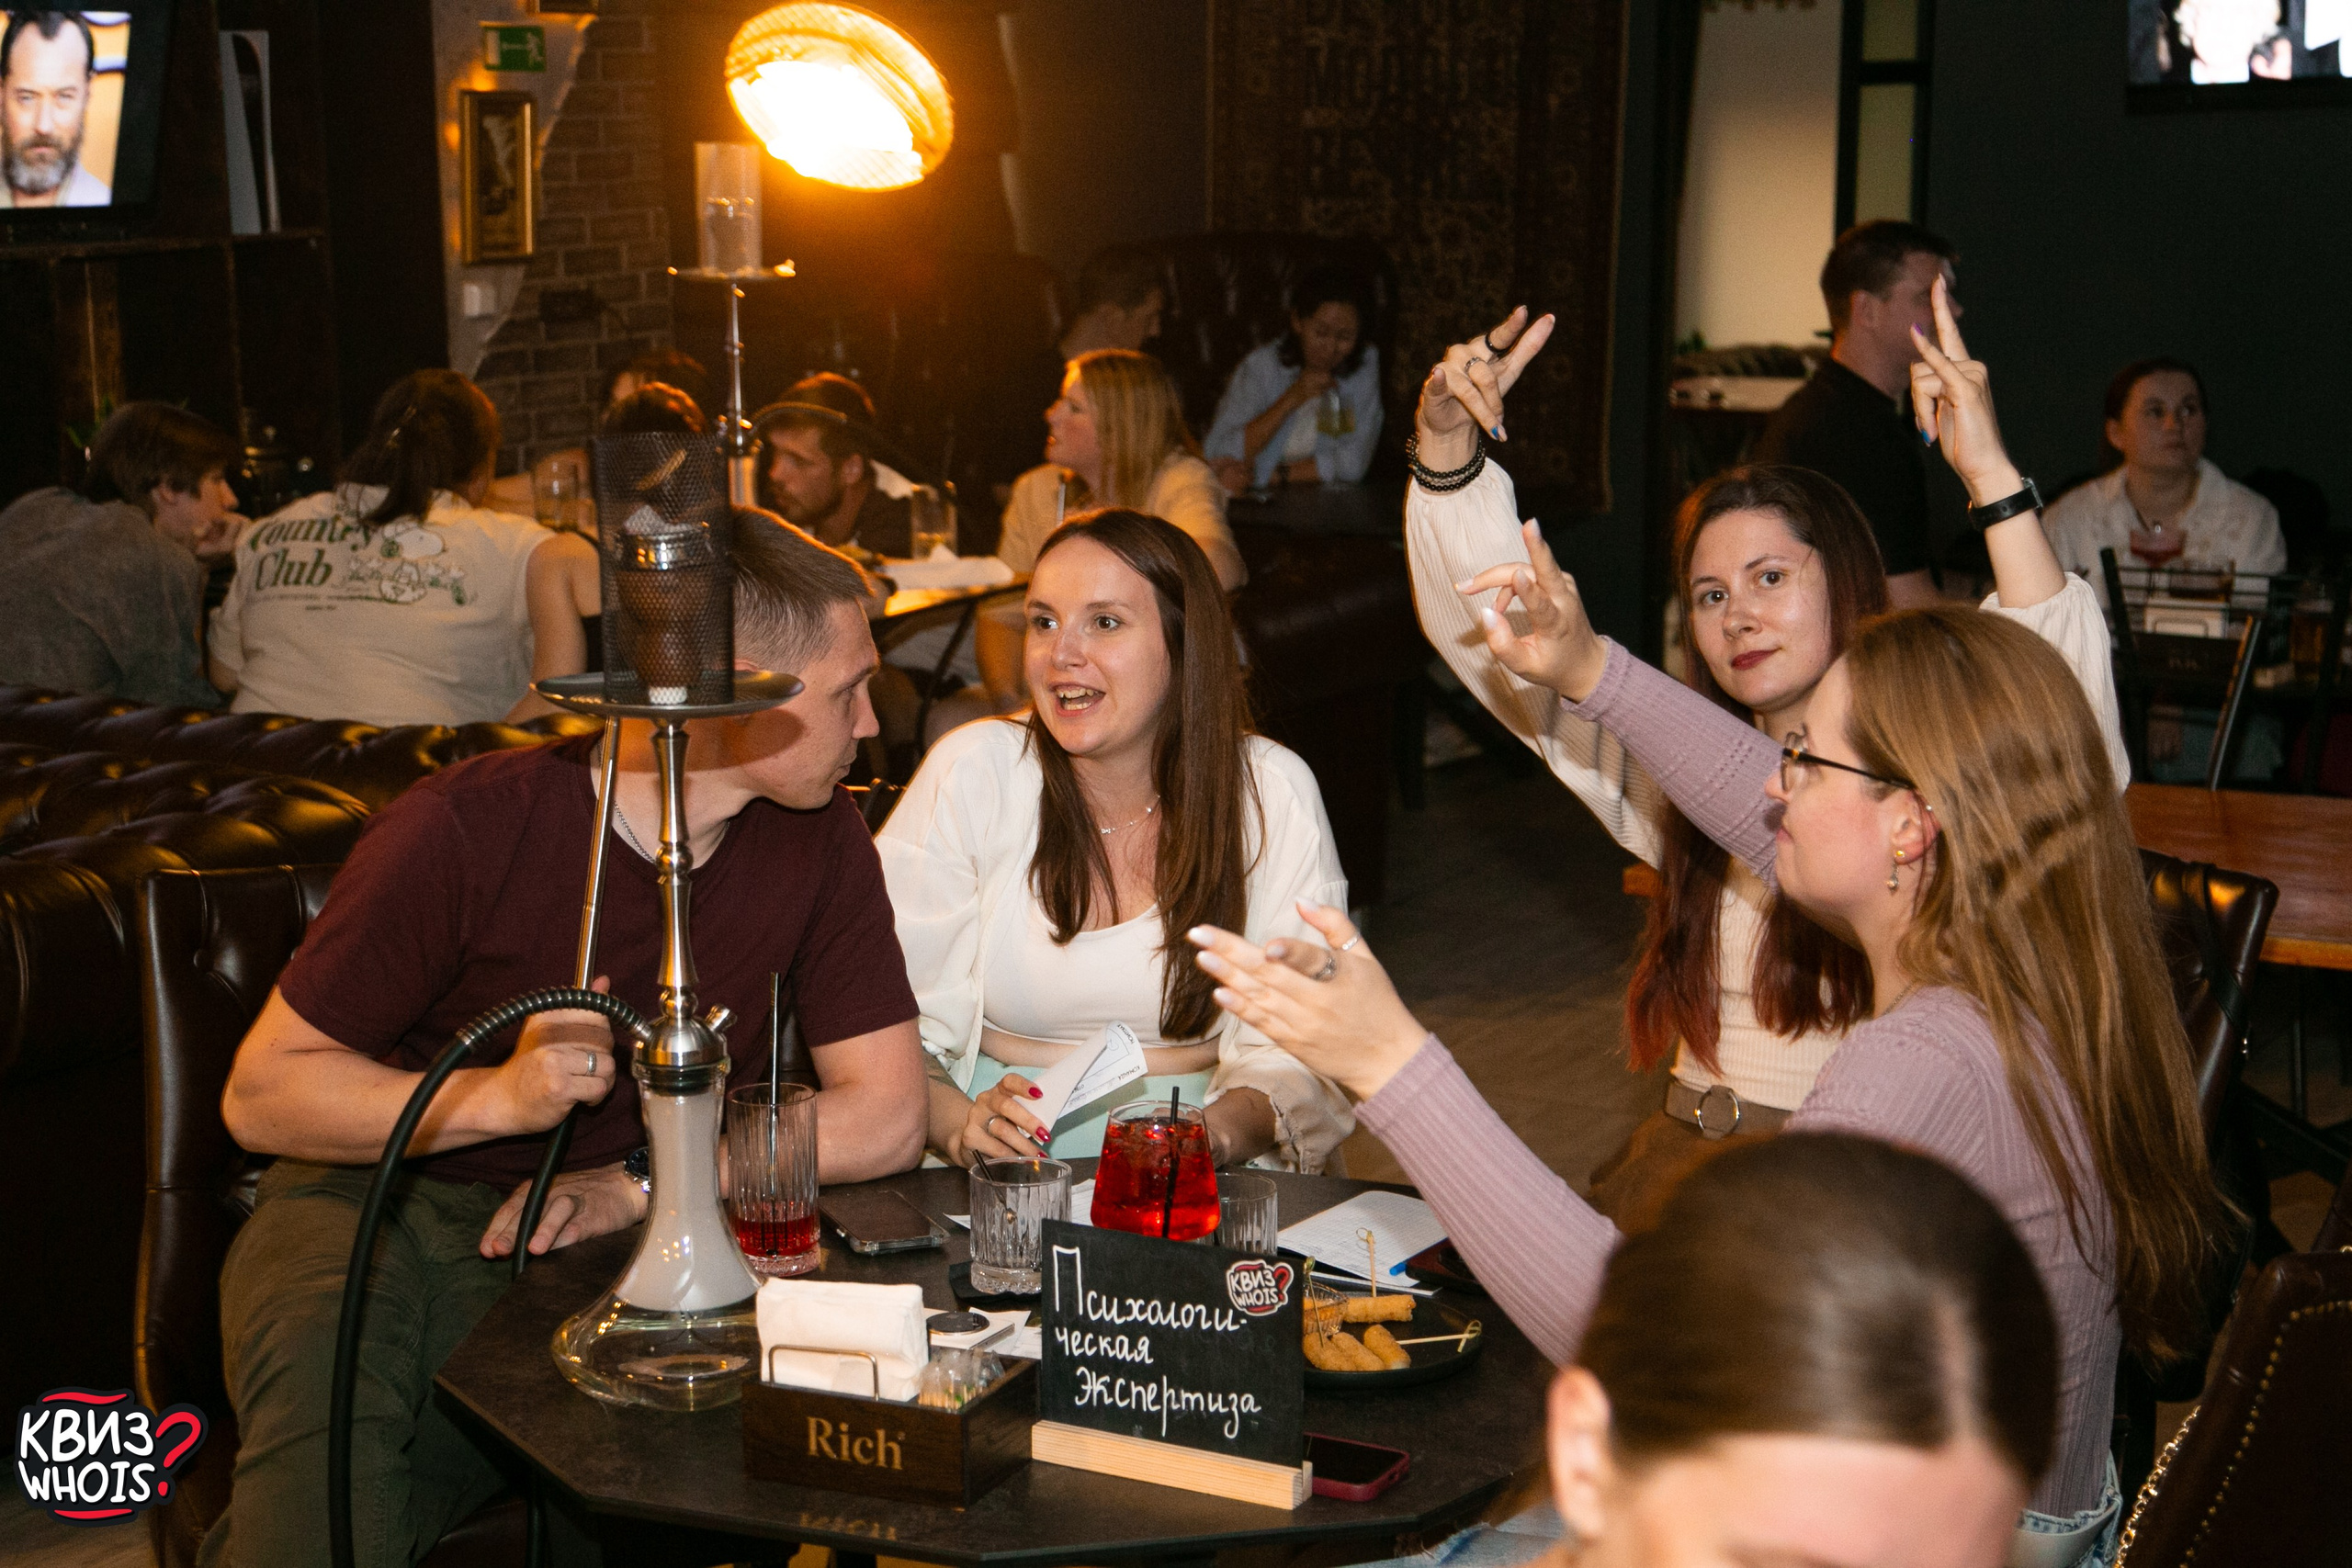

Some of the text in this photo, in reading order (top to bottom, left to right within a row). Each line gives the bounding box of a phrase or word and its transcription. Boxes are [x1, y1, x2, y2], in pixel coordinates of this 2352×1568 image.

[255, 547, 334, 592] Club
[1231, 1269, 1276, 1292] КВИЗ
[1055, 1326, 1154, 1365] ческая
[1074, 1366, 1262, 1439] Экспертиза
[806, 1416, 904, 1471] Rich
